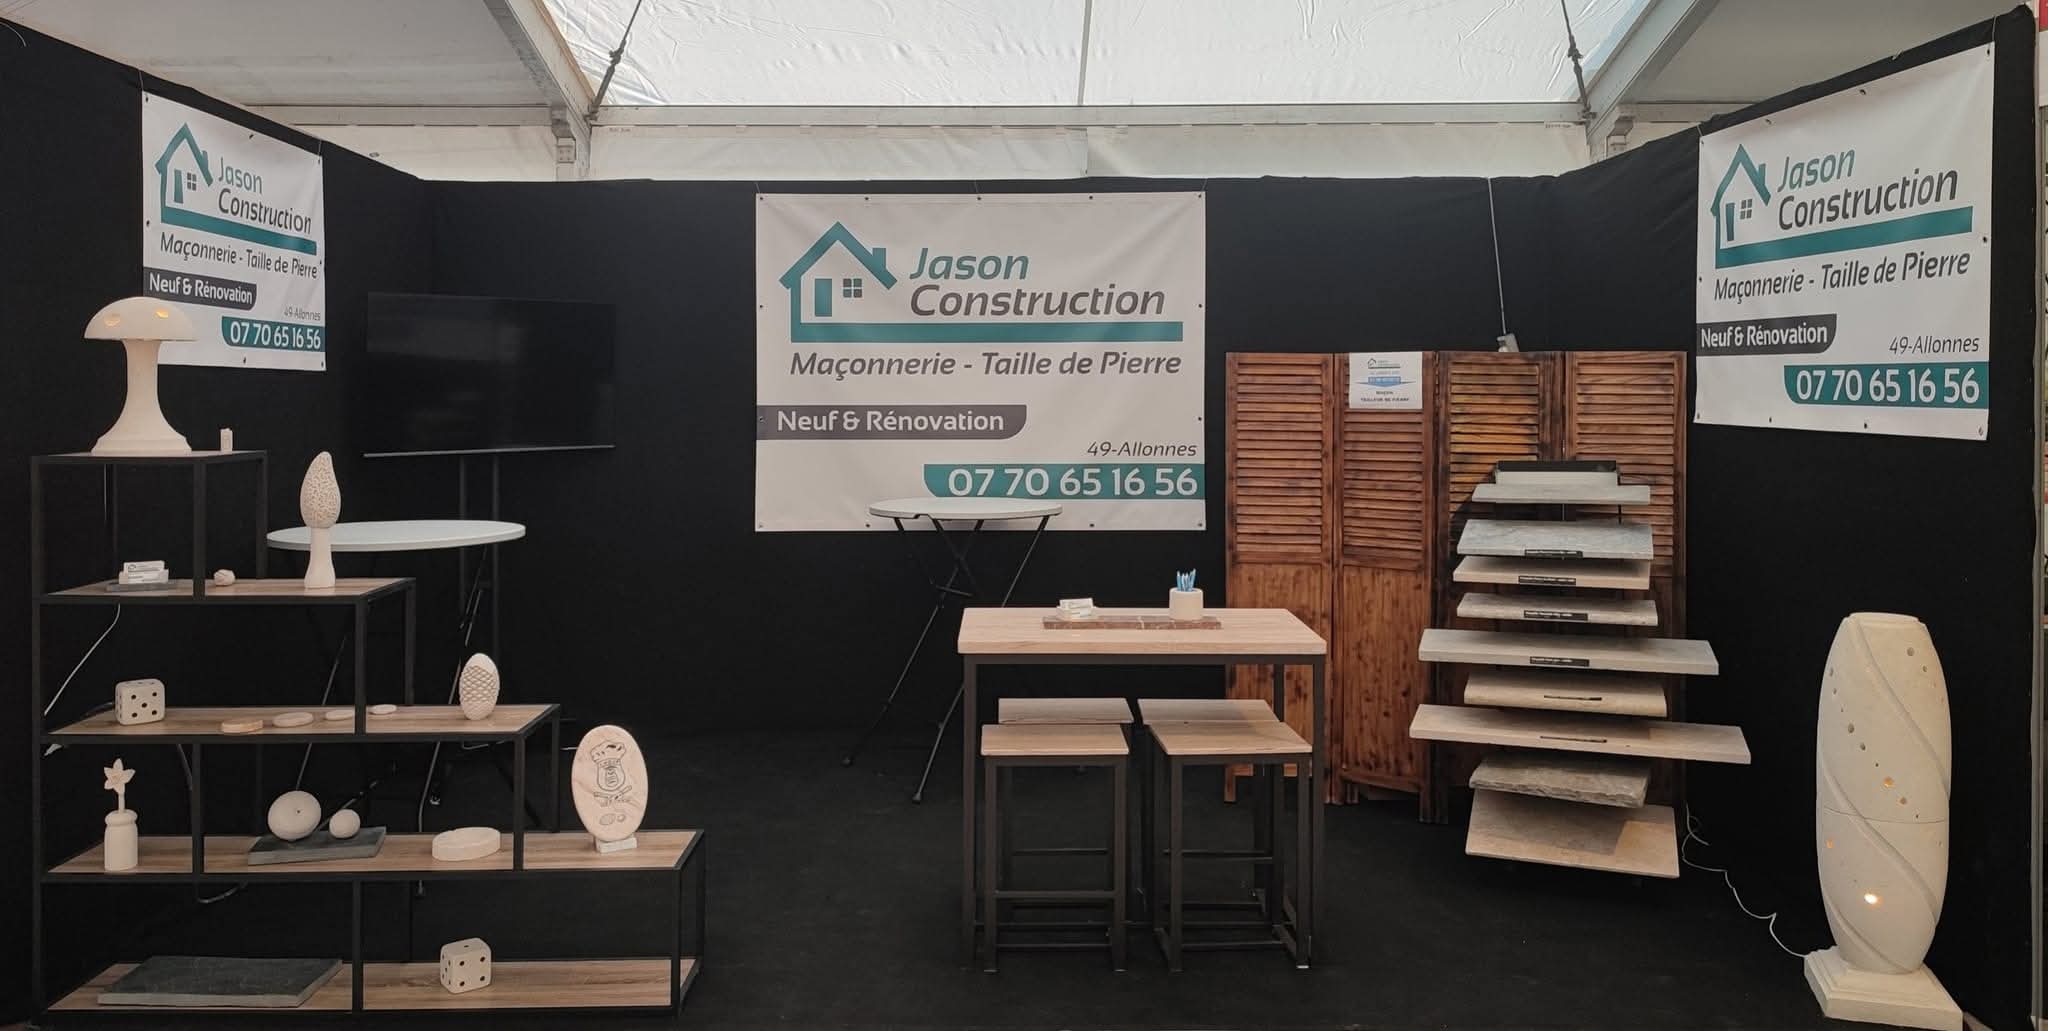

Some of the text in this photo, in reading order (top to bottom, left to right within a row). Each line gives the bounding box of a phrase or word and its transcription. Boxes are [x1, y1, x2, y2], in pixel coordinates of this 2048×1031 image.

[218, 157, 263, 194] Jason
[1777, 148, 1855, 193] Jason
[218, 188, 312, 235] Construction
[1779, 168, 1958, 230] Construction
[160, 231, 237, 265] Maçonnerie
[246, 249, 272, 271] Taille
[274, 258, 289, 275] de
[291, 258, 318, 279] Pierre
[909, 248, 1030, 280] Jason
[149, 273, 253, 304] Neuf & Rénovation
[1714, 269, 1804, 304] Maçonnerie
[1821, 259, 1869, 289] Taille
[1873, 257, 1898, 284] de
[1902, 251, 1971, 281] Pierre
[910, 284, 1165, 316] Construction
[230, 321, 321, 349] 07 70 65 16 56
[1700, 323, 1828, 348] Neuf & Rénovation
[1889, 336, 1979, 354] 49-Allonnes
[790, 352, 956, 381] Maçonnerie
[981, 351, 1051, 376] Taille
[1059, 351, 1093, 375] de
[1100, 351, 1181, 375] Pierre
[1796, 369, 1980, 403] 07 70 65 16 56
[777, 407, 1004, 432] Neuf & Rénovation
[1086, 440, 1197, 457] 49-Allonnes
[948, 468, 1198, 496] 07 70 65 16 56
